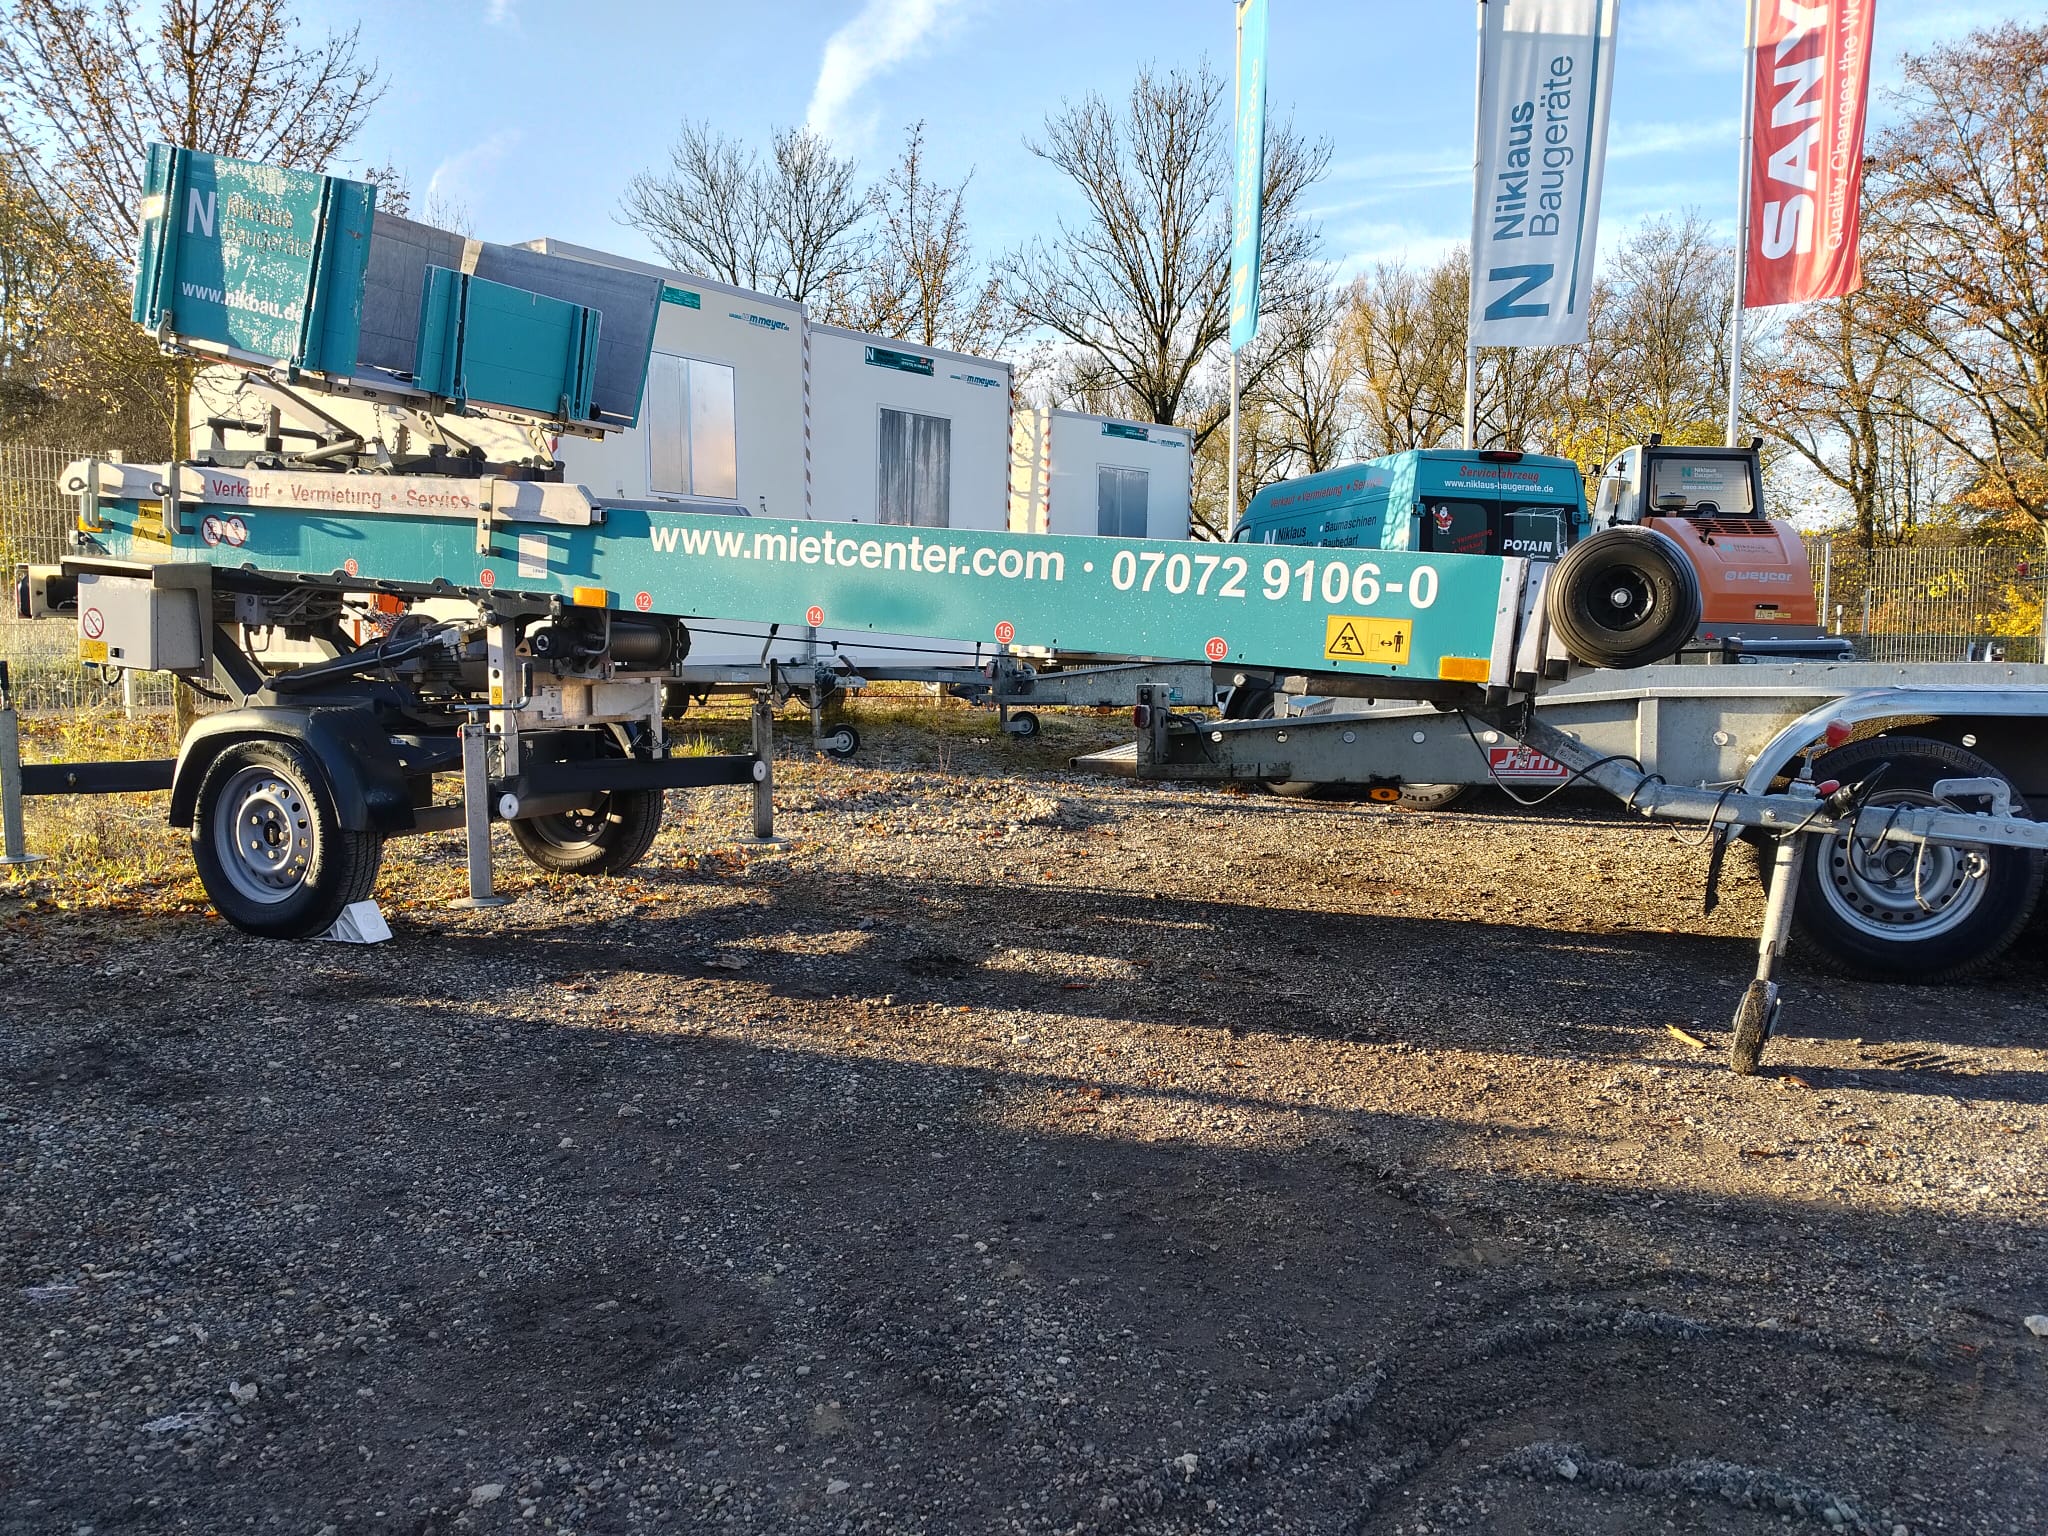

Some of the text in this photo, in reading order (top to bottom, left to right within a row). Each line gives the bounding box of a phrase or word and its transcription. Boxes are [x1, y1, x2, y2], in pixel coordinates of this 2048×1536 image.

[1841, 34, 1859, 76] the
[1761, 0, 1828, 259] SANY
[1830, 76, 1856, 175] Changes
[1530, 55, 1573, 237] Baugeräte
[1493, 101, 1535, 241] Niklaus
[186, 187, 216, 237] N
[226, 193, 294, 229] Niklaus
[1827, 177, 1850, 249] Quality
[1484, 263, 1554, 321] N
[1459, 465, 1540, 483] Servicefahrzeug
[212, 480, 470, 509] Verkauf Vermietung Service
[1302, 484, 1343, 501] Vermietung
[1444, 479, 1554, 493] www.niklaus-baugeraete.de
[1325, 515, 1377, 532] Baumaschinen
[1278, 526, 1306, 541] Niklaus
[1322, 535, 1359, 547] Baubedarf
[1504, 539, 1552, 552] POTAIN
[650, 525, 1438, 609] www.mietcenter.com 07072 9106-0
[482, 572, 493, 583] 10
[1738, 571, 1793, 583] weycor
[638, 596, 649, 606] 12
[810, 610, 821, 621] 14
[998, 626, 1012, 637] 16
[1210, 643, 1224, 654] 18
